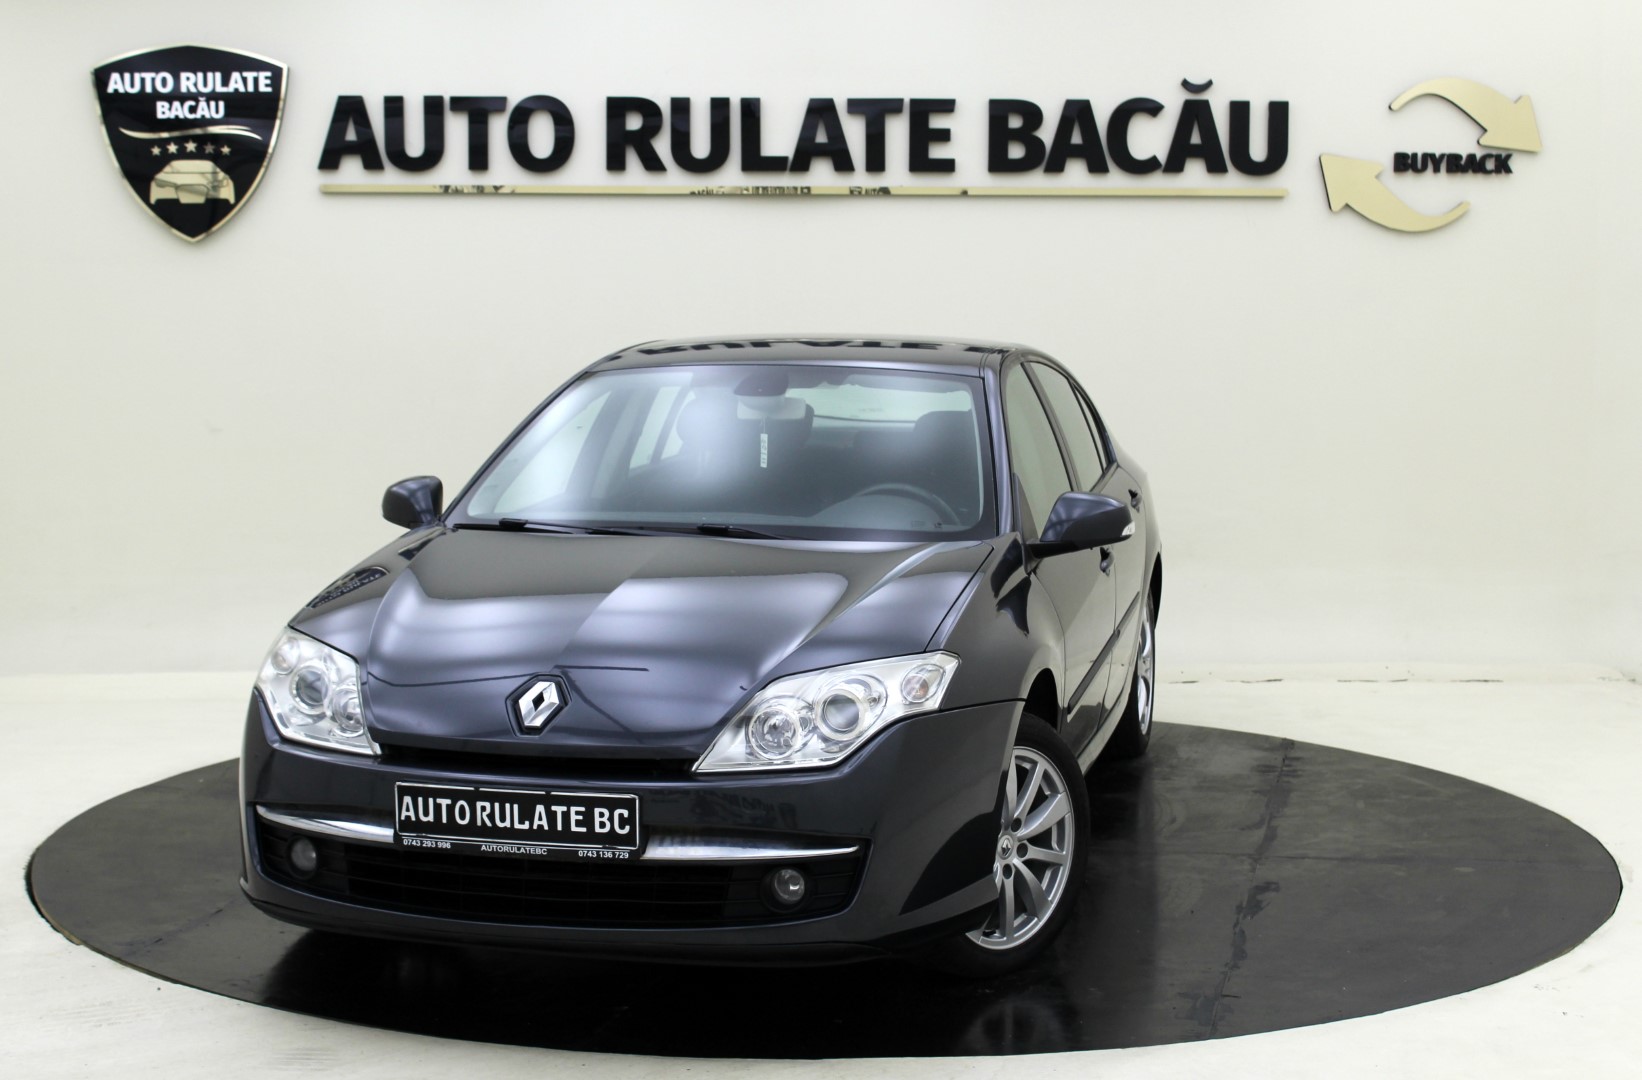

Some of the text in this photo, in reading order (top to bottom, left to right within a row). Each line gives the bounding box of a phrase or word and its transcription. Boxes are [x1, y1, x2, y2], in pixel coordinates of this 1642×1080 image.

[107, 71, 273, 94] AUTO RULATE
[155, 96, 226, 120] BACĂU
[318, 78, 1290, 176] AUTO RULATE BACĂU
[1393, 151, 1514, 174] BUYBACK
[400, 795, 631, 835] AUTO RULATE BC
[402, 838, 452, 850] 0743 293 996
[480, 844, 549, 856] AUTORULATEBC
[578, 850, 630, 860] 0743 136 729
